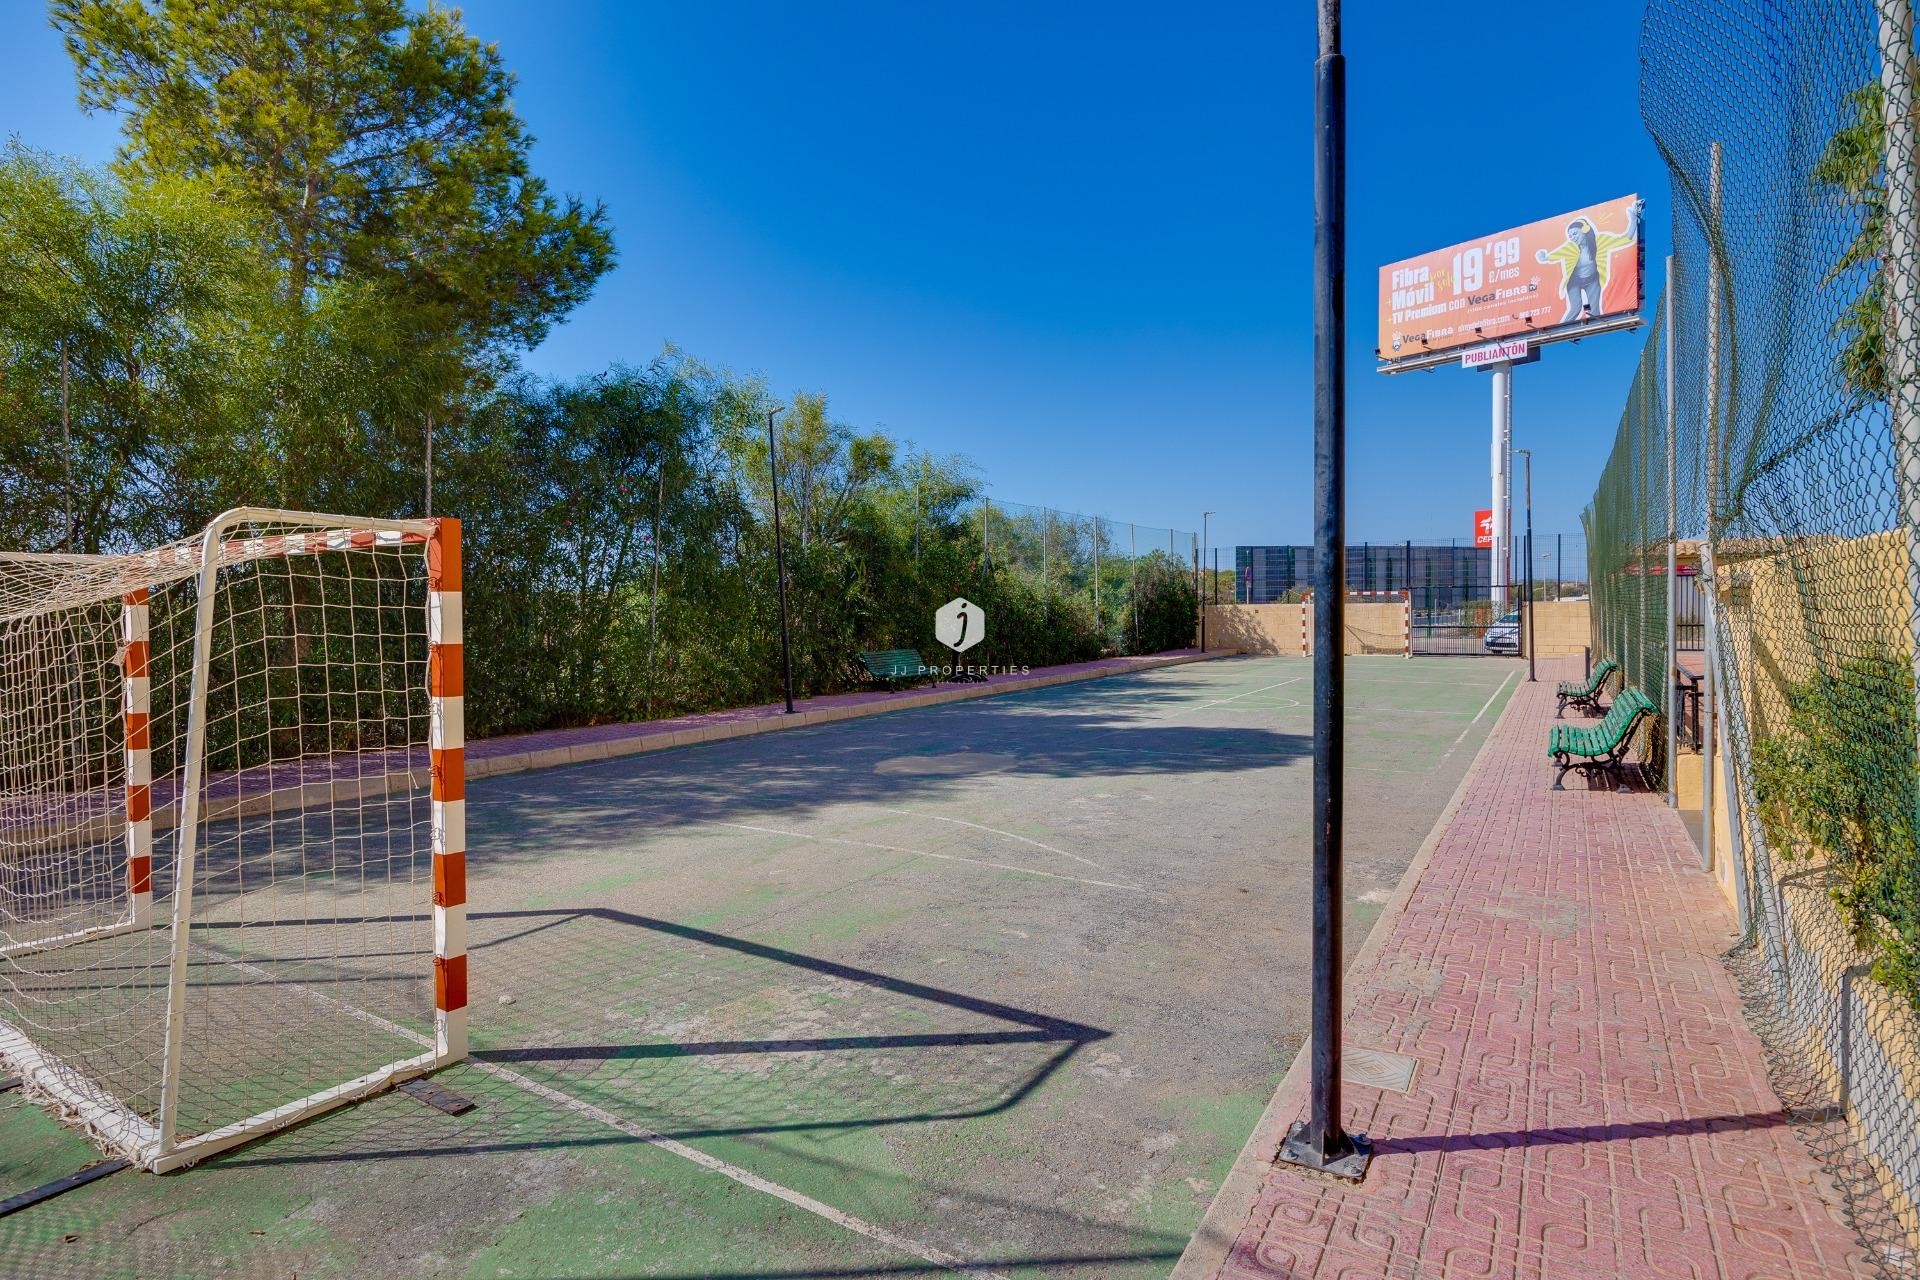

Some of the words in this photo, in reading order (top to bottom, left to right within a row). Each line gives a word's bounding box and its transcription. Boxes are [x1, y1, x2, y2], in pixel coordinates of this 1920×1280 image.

[1392, 266, 1429, 290] Fibra
[1392, 282, 1434, 310] Móvil
[1391, 311, 1404, 324] TV
[1406, 303, 1446, 320] Premium
[1449, 298, 1465, 311] con
[1465, 343, 1525, 364] PUBLIANTÓN
